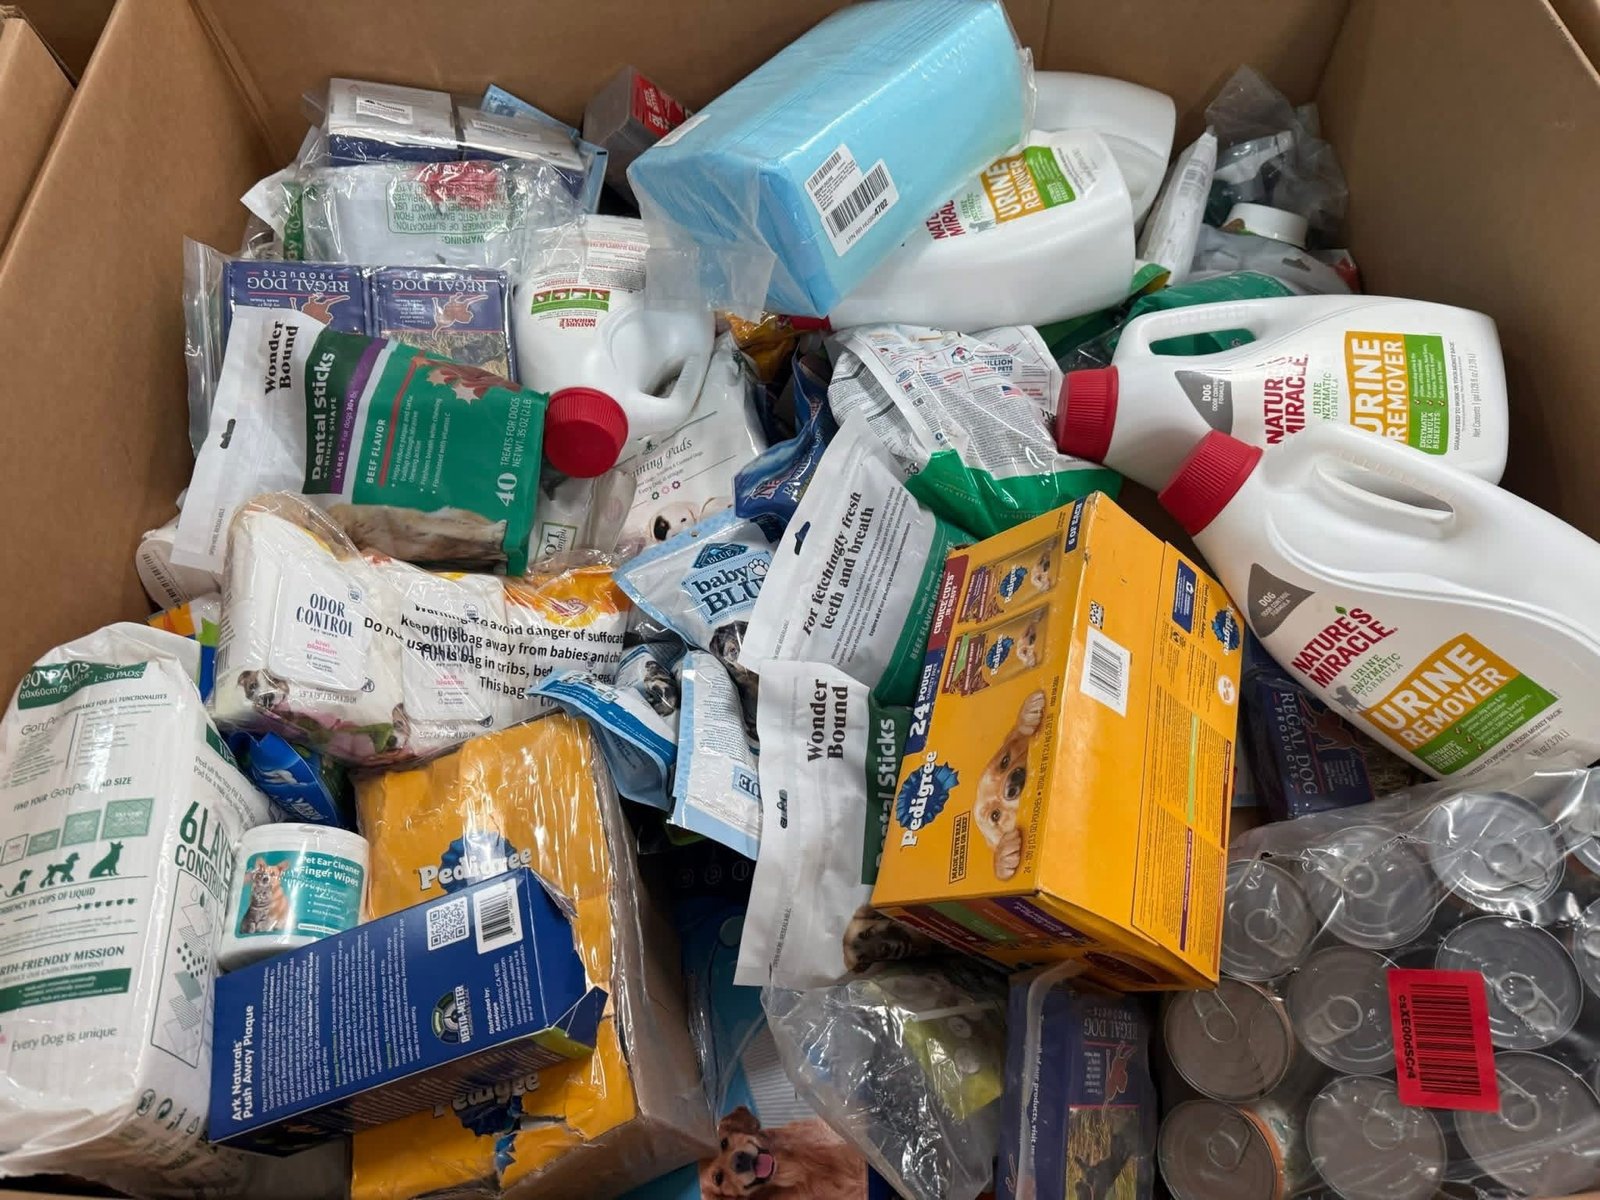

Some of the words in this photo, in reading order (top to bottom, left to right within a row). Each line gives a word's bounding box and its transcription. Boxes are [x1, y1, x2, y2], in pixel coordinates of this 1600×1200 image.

[989, 162, 1021, 218] URINE
[1009, 158, 1041, 211] REMOVER
[440, 235, 485, 245] WARNING:
[449, 222, 459, 231] OF
[247, 277, 288, 290] DOG
[263, 269, 334, 280] PRODUCTS
[291, 280, 350, 293] REGAL
[392, 280, 430, 291] DOG
[436, 280, 488, 292] REGAL
[265, 321, 285, 395] Wonder
[279, 325, 299, 389] Bound
[314, 352, 336, 410] Sticks
[1202, 384, 1212, 402] DOG
[1313, 382, 1322, 415] URINE
[1351, 338, 1385, 436] URINE
[1383, 341, 1407, 441] REMOVER
[329, 397, 337, 431] SHAPE
[508, 397, 520, 420] DOGS
[335, 451, 345, 479] LARGE
[344, 412, 353, 429] dogs
[371, 419, 387, 457] FLAVOR
[506, 420, 516, 437] FOR
[512, 453, 522, 467] NET
[520, 417, 529, 428] OZ
[1420, 411, 1428, 449] ENZYMATIC
[1426, 412, 1434, 449] FORMULA
[1433, 412, 1441, 450] BENEFITS
[312, 413, 327, 481] Dental
[501, 437, 514, 466] TREATS
[665, 437, 693, 458] Pads
[365, 458, 378, 484] BEEF
[496, 472, 518, 507] 40
[847, 506, 875, 555] breath
[1069, 527, 1077, 538] OF
[1071, 502, 1083, 527] EACH
[707, 549, 736, 564] BLUE
[1068, 537, 1074, 546] 6
[692, 564, 749, 595] baby
[802, 607, 819, 637] For
[811, 532, 849, 606] fetchingly
[842, 492, 862, 529] fresh
[839, 558, 856, 588] and
[701, 577, 766, 617] BLU
[946, 607, 952, 617] IN
[949, 585, 958, 607] GRAVY
[1005, 563, 1018, 603] Pedigree
[1258, 591, 1277, 607] DOG
[296, 606, 354, 638] CONTROL
[309, 593, 345, 618] ODOR
[820, 592, 845, 630] teeth
[933, 599, 949, 635] CHOICE
[944, 573, 955, 598] CUTS
[461, 627, 483, 649] bag
[485, 638, 516, 656] away
[518, 642, 547, 657] from
[549, 645, 588, 661] babies
[590, 652, 609, 663] and
[490, 619, 523, 635] avoid
[526, 625, 571, 640] danger
[573, 629, 586, 640] of
[868, 619, 880, 637] Explore
[910, 638, 922, 660] BEEF
[919, 604, 934, 638] FLAVOR
[1223, 603, 1235, 656] Pedigree
[1291, 607, 1373, 675] NATURE'S
[364, 617, 383, 632] Do
[407, 639, 432, 653] use
[485, 656, 495, 669] in
[497, 661, 530, 679] cribs,
[990, 634, 1004, 676] Pedigree
[1309, 620, 1396, 689] MIRACLE
[22, 671, 40, 689] 30
[918, 664, 933, 702] POUCH
[1351, 654, 1383, 681] URINE
[1351, 652, 1401, 695] ENZYMATIC
[1361, 663, 1404, 697] FORMULA
[479, 676, 501, 692] This
[503, 682, 526, 699] bag
[1371, 642, 1487, 731] URINE
[807, 678, 828, 763] Wonder
[827, 685, 849, 761] Bound
[909, 702, 931, 738] 24
[1400, 665, 1509, 747] REMOVER
[1275, 707, 1300, 779] PRODUCTS
[1281, 693, 1305, 749] REGAL
[1296, 754, 1319, 795] DOG
[1514, 733, 1528, 746] YOUR
[1528, 721, 1547, 736] MONEY
[876, 718, 896, 787] Sticks
[113, 776, 132, 786] SIZE
[901, 751, 937, 848] Pedigree
[179, 800, 199, 844] 6
[955, 816, 963, 840] REAL
[300, 855, 316, 866] Pet
[317, 857, 332, 867] Ear
[333, 860, 360, 876] Cleaner
[418, 848, 532, 891] Pedigree
[957, 845, 965, 876] CHICKEN
[961, 834, 966, 845] OR
[57, 891, 67, 901] OF
[69, 887, 96, 899] LIQUID
[300, 866, 331, 879] Finger
[333, 871, 359, 887] Wipes
[74, 945, 125, 961] MISSION
[484, 986, 493, 998] by:
[243, 1005, 254, 1045] Plaque
[455, 984, 470, 1043] DENTA-METER
[485, 998, 496, 1035] Distributed
[492, 1002, 502, 1032] Antelope
[1083, 1018, 1106, 1037] DOG
[12, 1038, 39, 1052] Every
[41, 1033, 65, 1047] Dog
[67, 1032, 77, 1042] is
[78, 1026, 117, 1042] unique
[1399, 994, 1417, 1079] csXE00dSCr4
[232, 1040, 243, 1093] Naturals
[243, 1050, 255, 1084] Away
[232, 1098, 243, 1121] Ark
[243, 1088, 253, 1119] Push
[1031, 1083, 1040, 1123] products,
